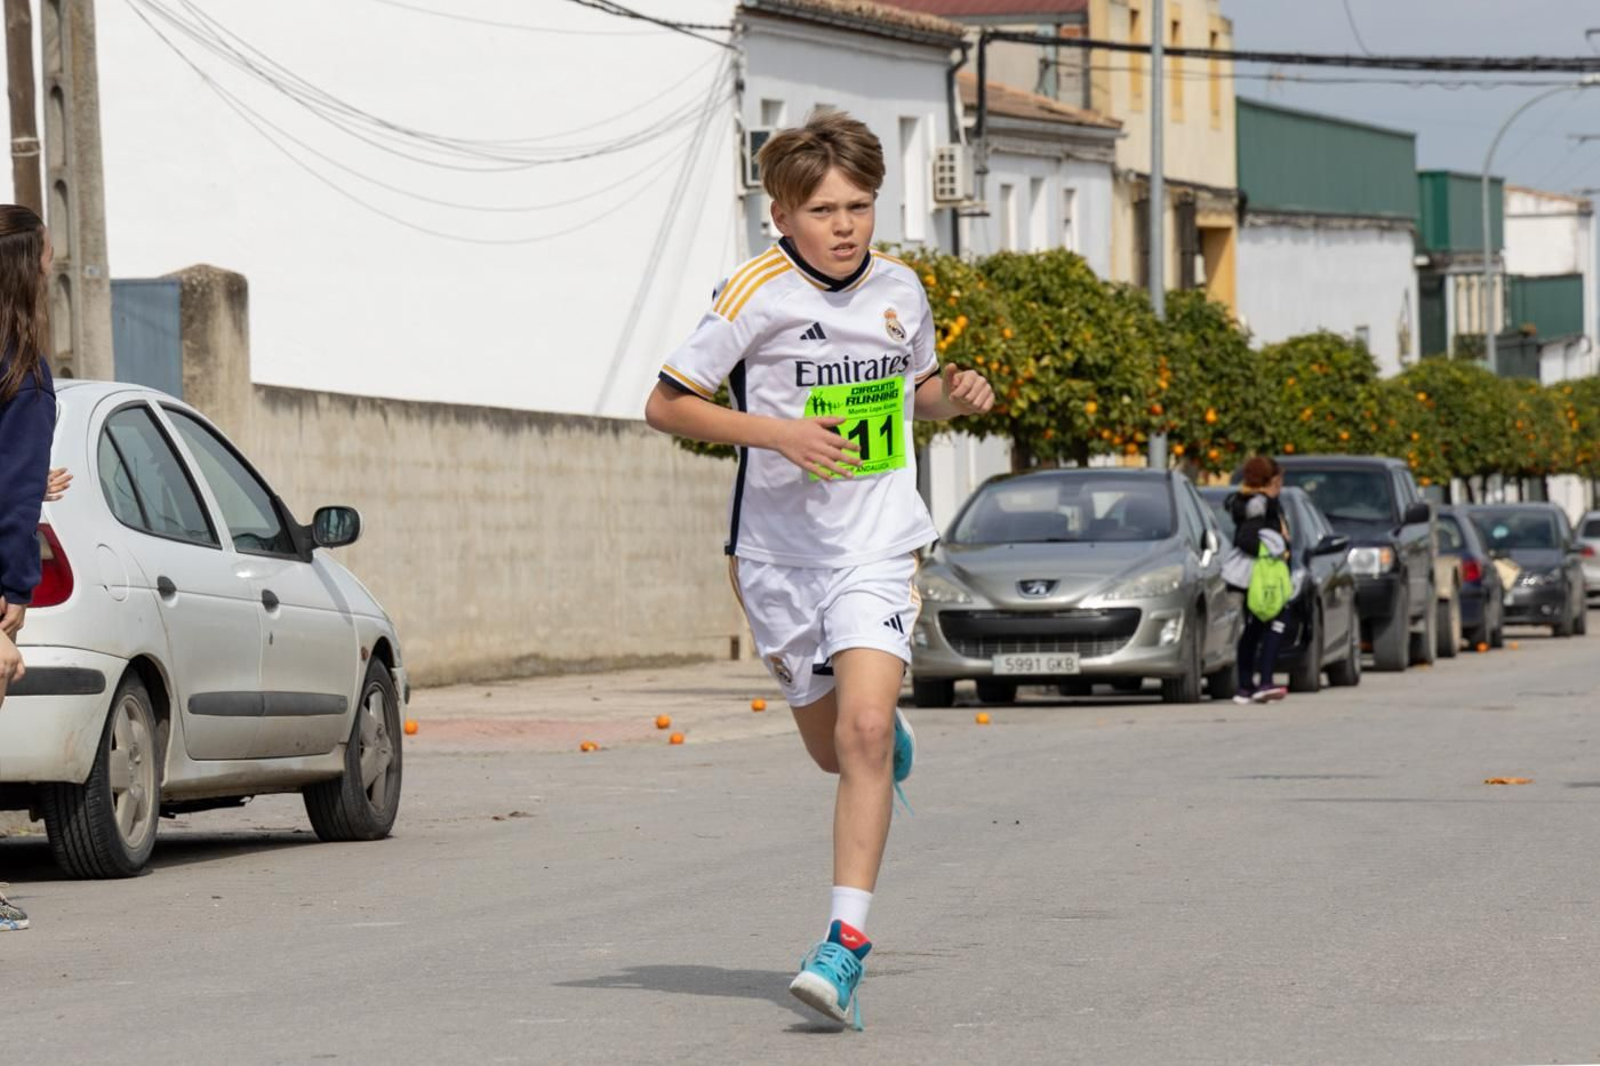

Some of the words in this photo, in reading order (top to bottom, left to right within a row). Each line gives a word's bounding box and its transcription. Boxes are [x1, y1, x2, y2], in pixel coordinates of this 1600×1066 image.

[795, 354, 911, 387] Emirates
[846, 388, 898, 406] RUNNING
[851, 381, 895, 395] CIRCUITO
[825, 414, 893, 460] 11
[1005, 657, 1042, 672] 5991
